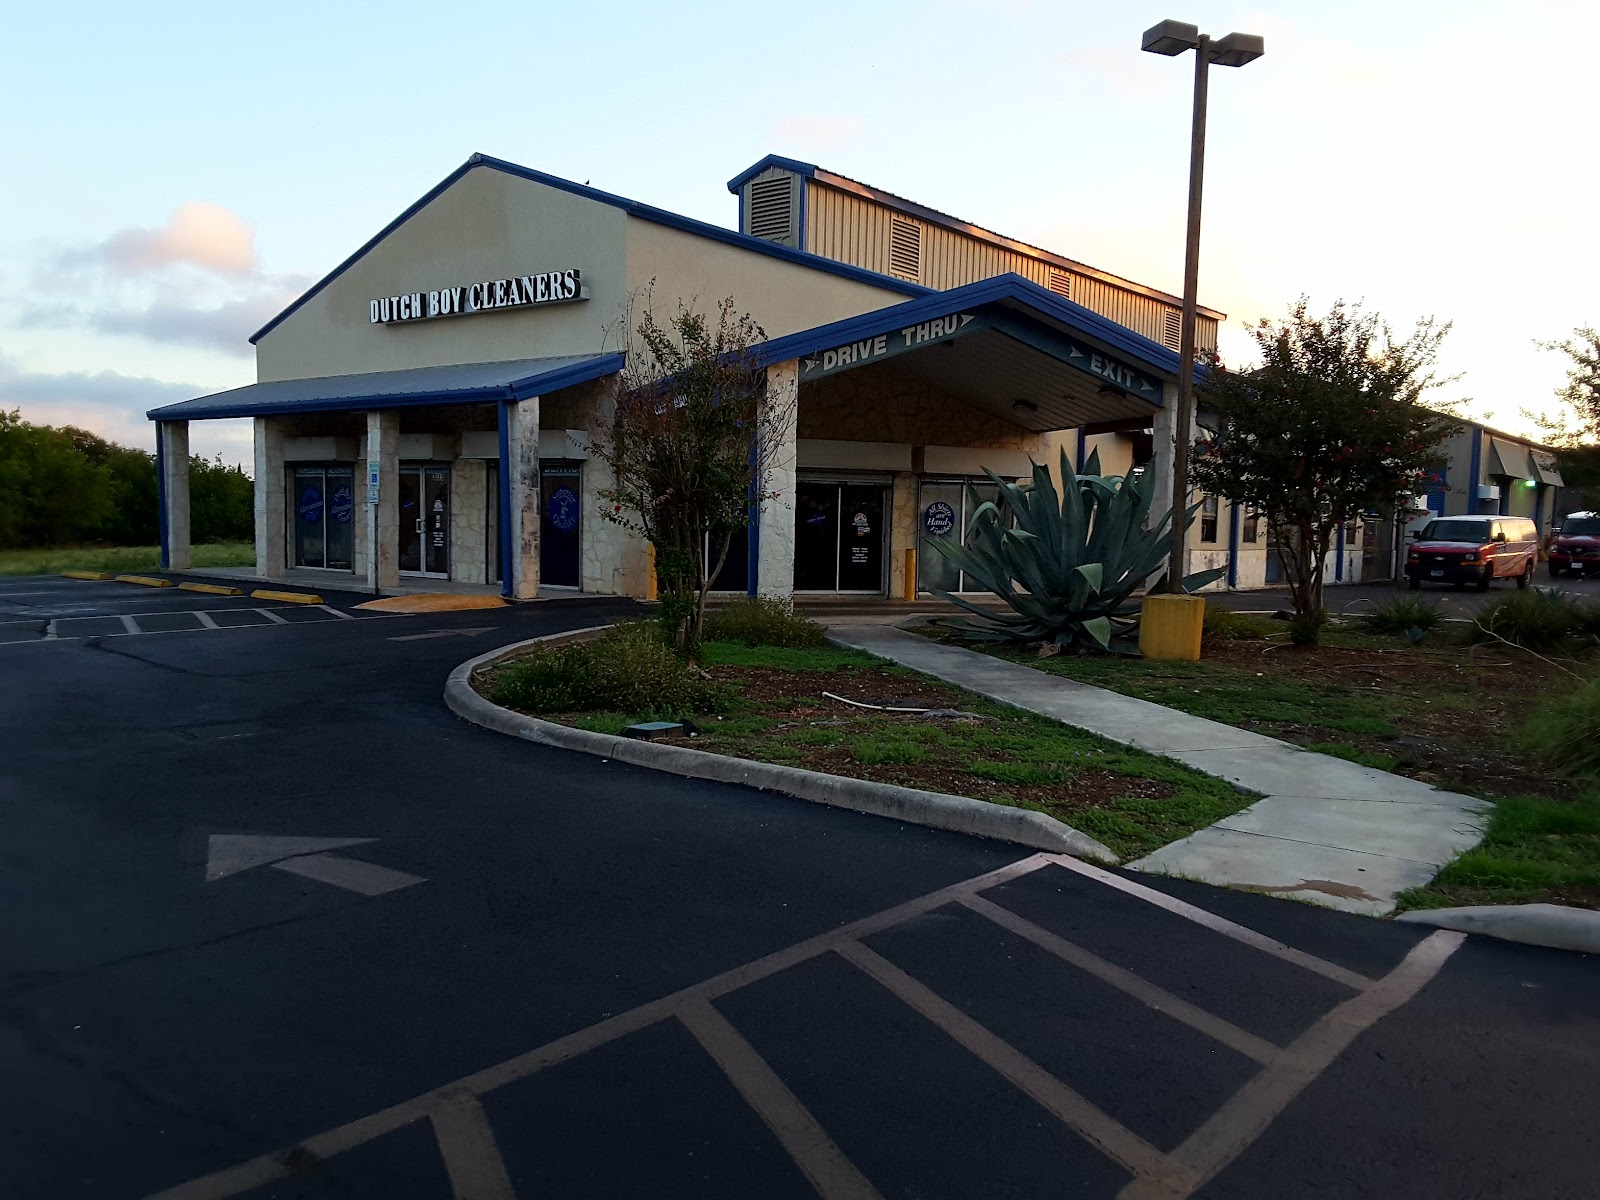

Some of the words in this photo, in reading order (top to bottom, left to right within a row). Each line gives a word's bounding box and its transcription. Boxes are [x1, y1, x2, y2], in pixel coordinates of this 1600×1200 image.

[370, 293, 421, 323] DUTCH
[429, 287, 462, 316] BOY
[469, 269, 577, 311] CLEANERS
[824, 335, 887, 371] DRIVE
[902, 314, 958, 347] THRU
[1091, 354, 1135, 388] EXIT
[927, 517, 949, 526] Hand
[928, 504, 937, 516] All
